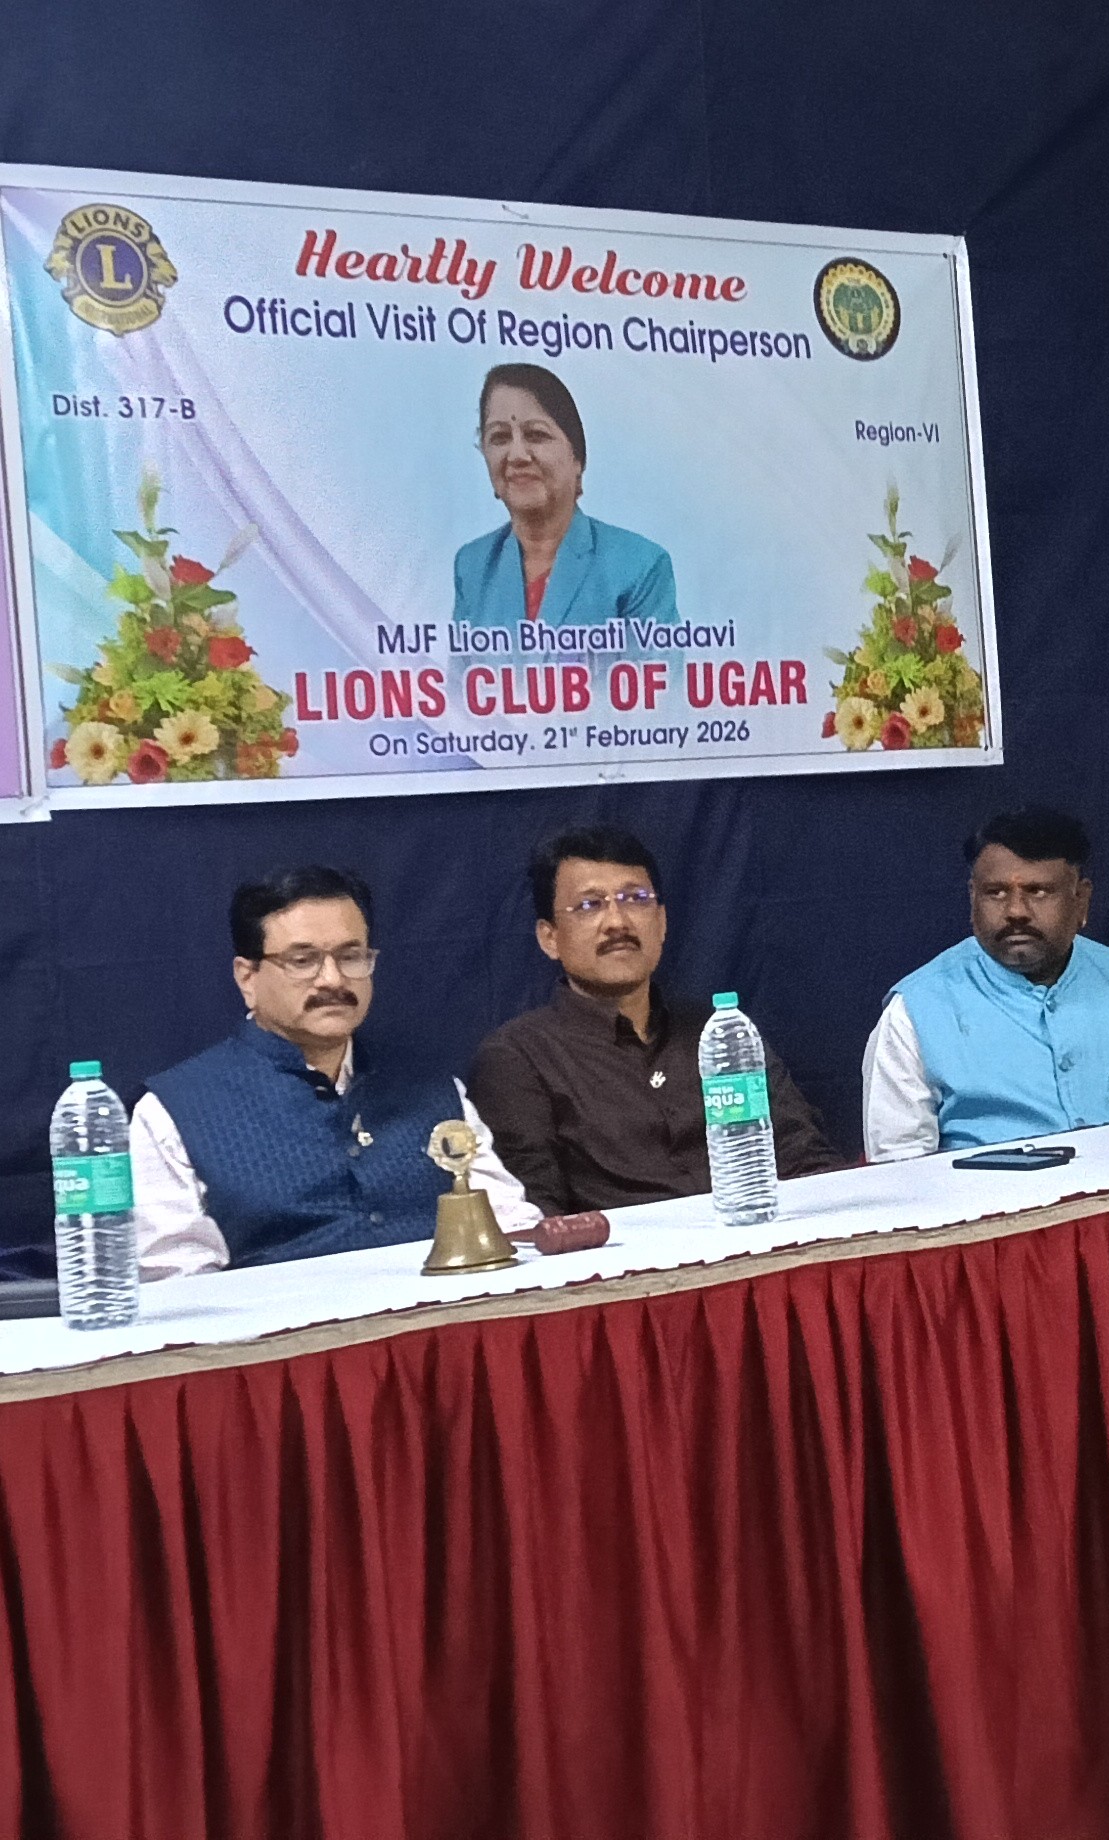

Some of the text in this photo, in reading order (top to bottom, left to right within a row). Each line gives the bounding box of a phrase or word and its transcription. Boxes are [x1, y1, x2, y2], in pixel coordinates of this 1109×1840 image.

[70, 209, 145, 238] LIONS
[96, 243, 133, 290] L
[295, 229, 747, 302] Heartly Welcome
[223, 295, 812, 363] Official Visit Of Region Chairperson
[52, 394, 197, 420] Dist. 317-B
[854, 420, 941, 447] Region-VI
[376, 618, 735, 655] MJF Lion Bharati Vadavi
[295, 659, 808, 722] LIONS CLUB OF UGAR
[369, 733, 409, 757] On
[585, 723, 689, 750] February
[696, 720, 750, 745] 2026
